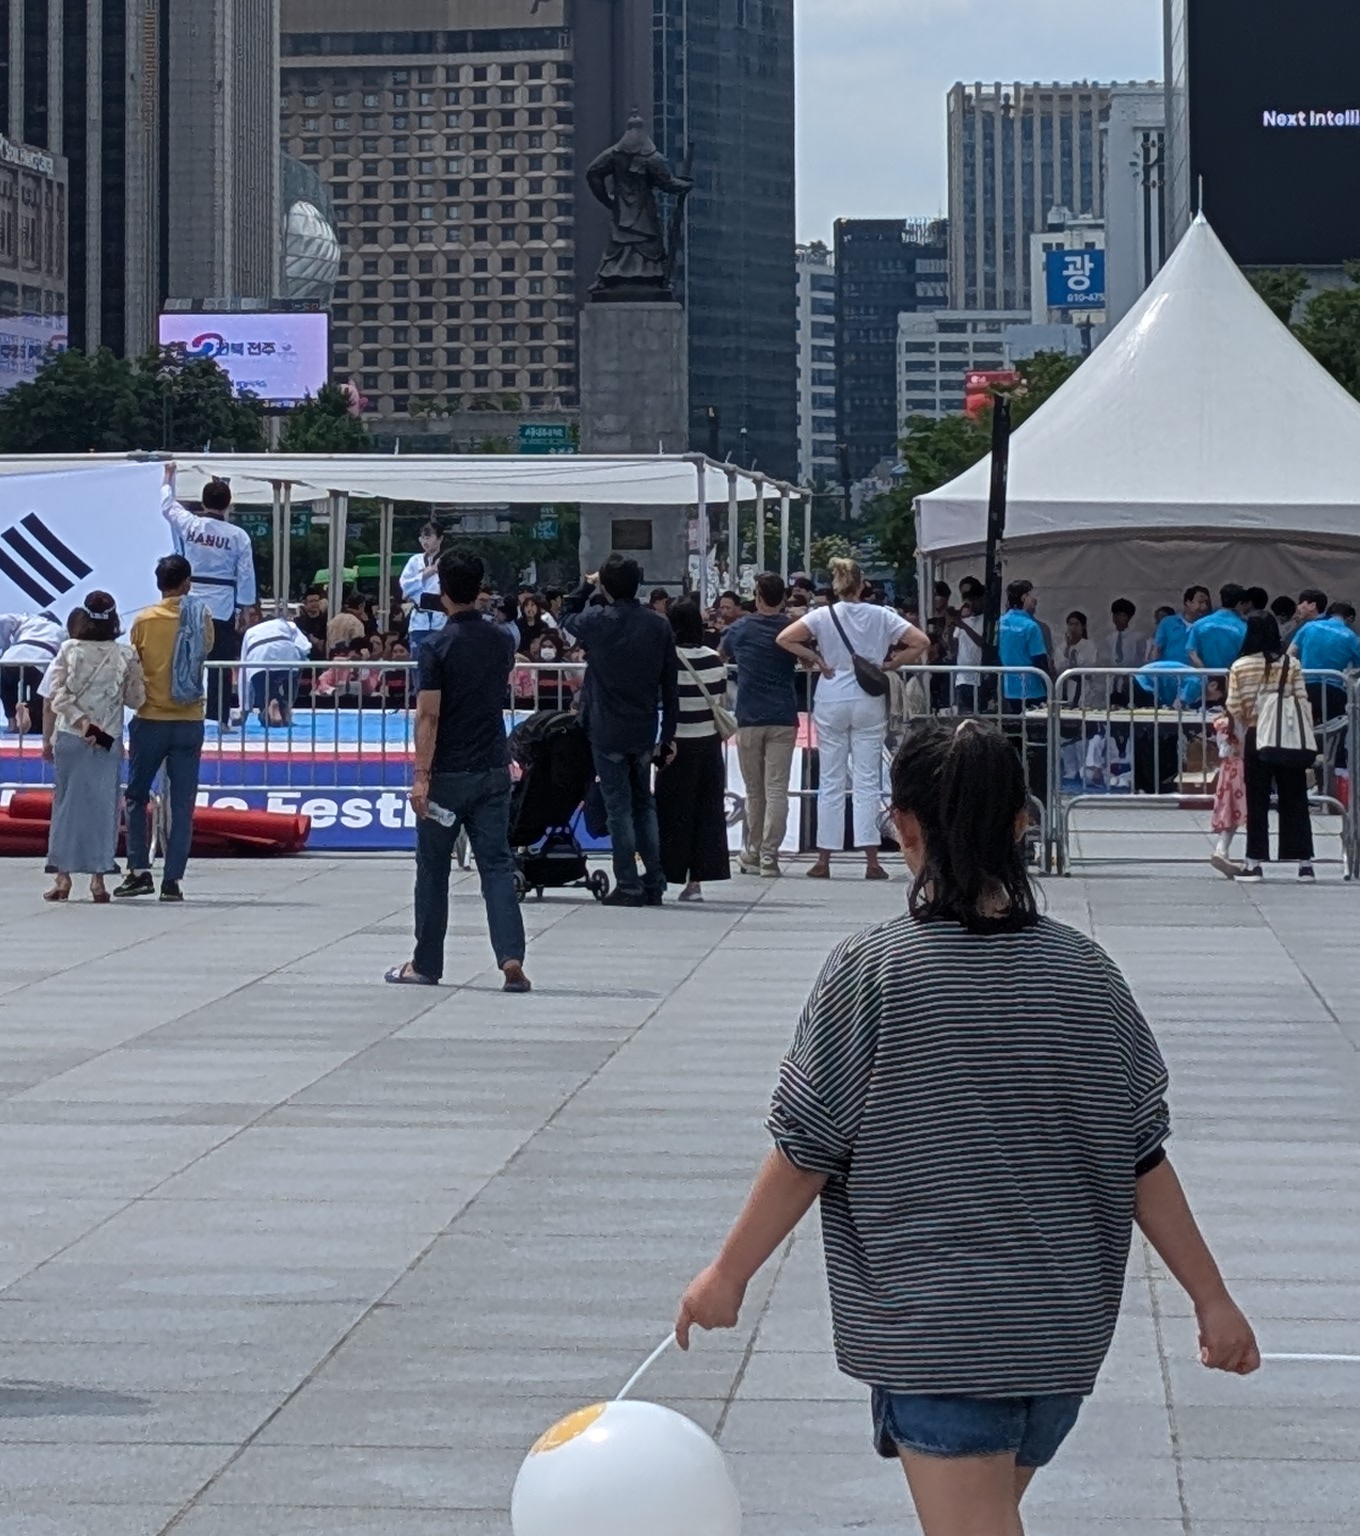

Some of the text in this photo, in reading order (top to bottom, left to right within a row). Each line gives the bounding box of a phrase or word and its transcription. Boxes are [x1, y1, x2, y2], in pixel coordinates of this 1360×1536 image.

[1263, 110, 1307, 127] Next
[1062, 254, 1095, 291] 광
[247, 341, 277, 357] 전주
